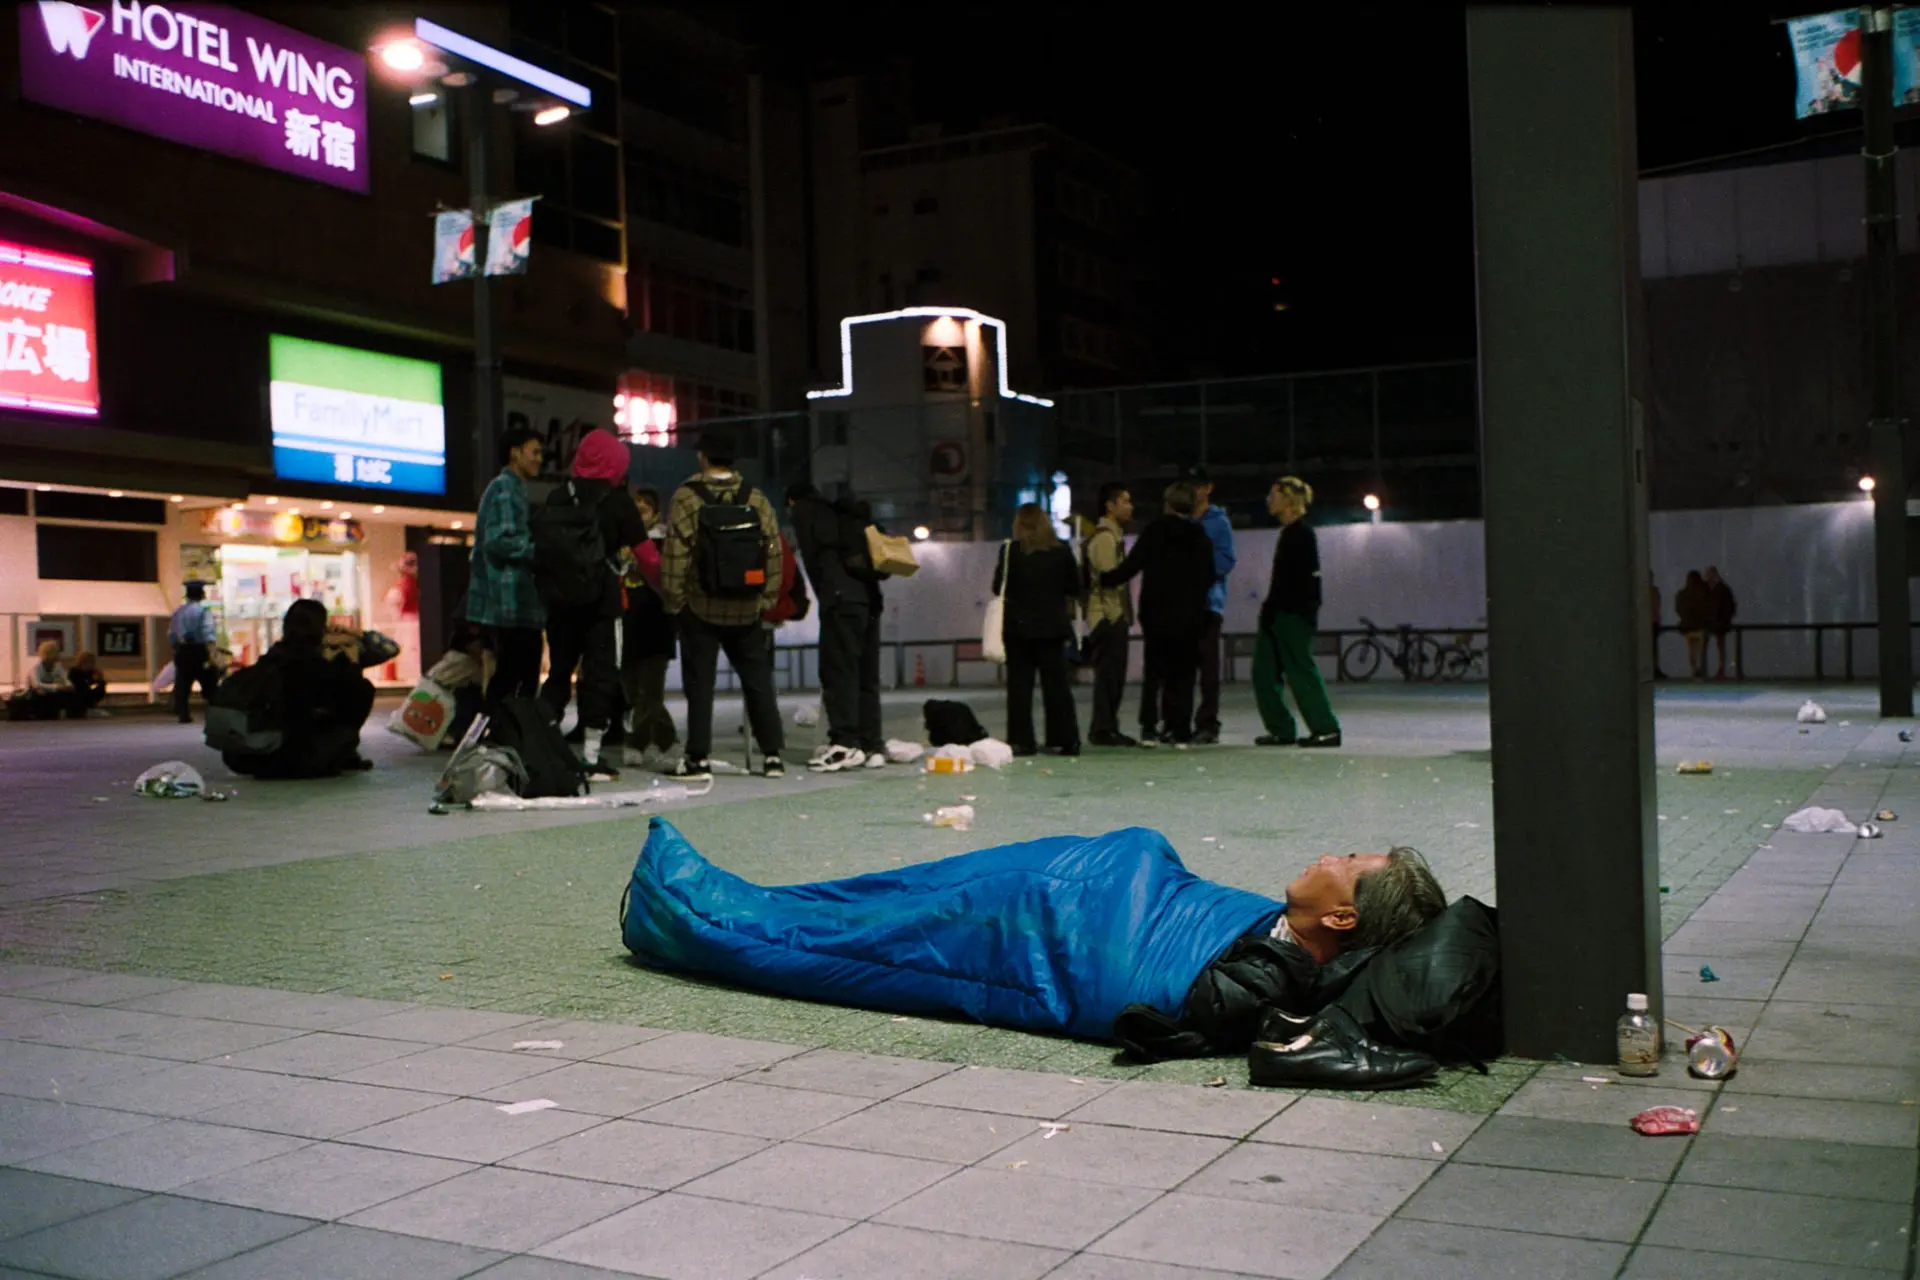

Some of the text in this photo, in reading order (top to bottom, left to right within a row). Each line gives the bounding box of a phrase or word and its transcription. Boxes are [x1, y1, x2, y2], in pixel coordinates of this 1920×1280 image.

[112, 0, 355, 110] HOTEL WING
[113, 53, 278, 124] INTERNATIONAL
[285, 108, 356, 171] 新宿
[0, 281, 52, 312] OKE
